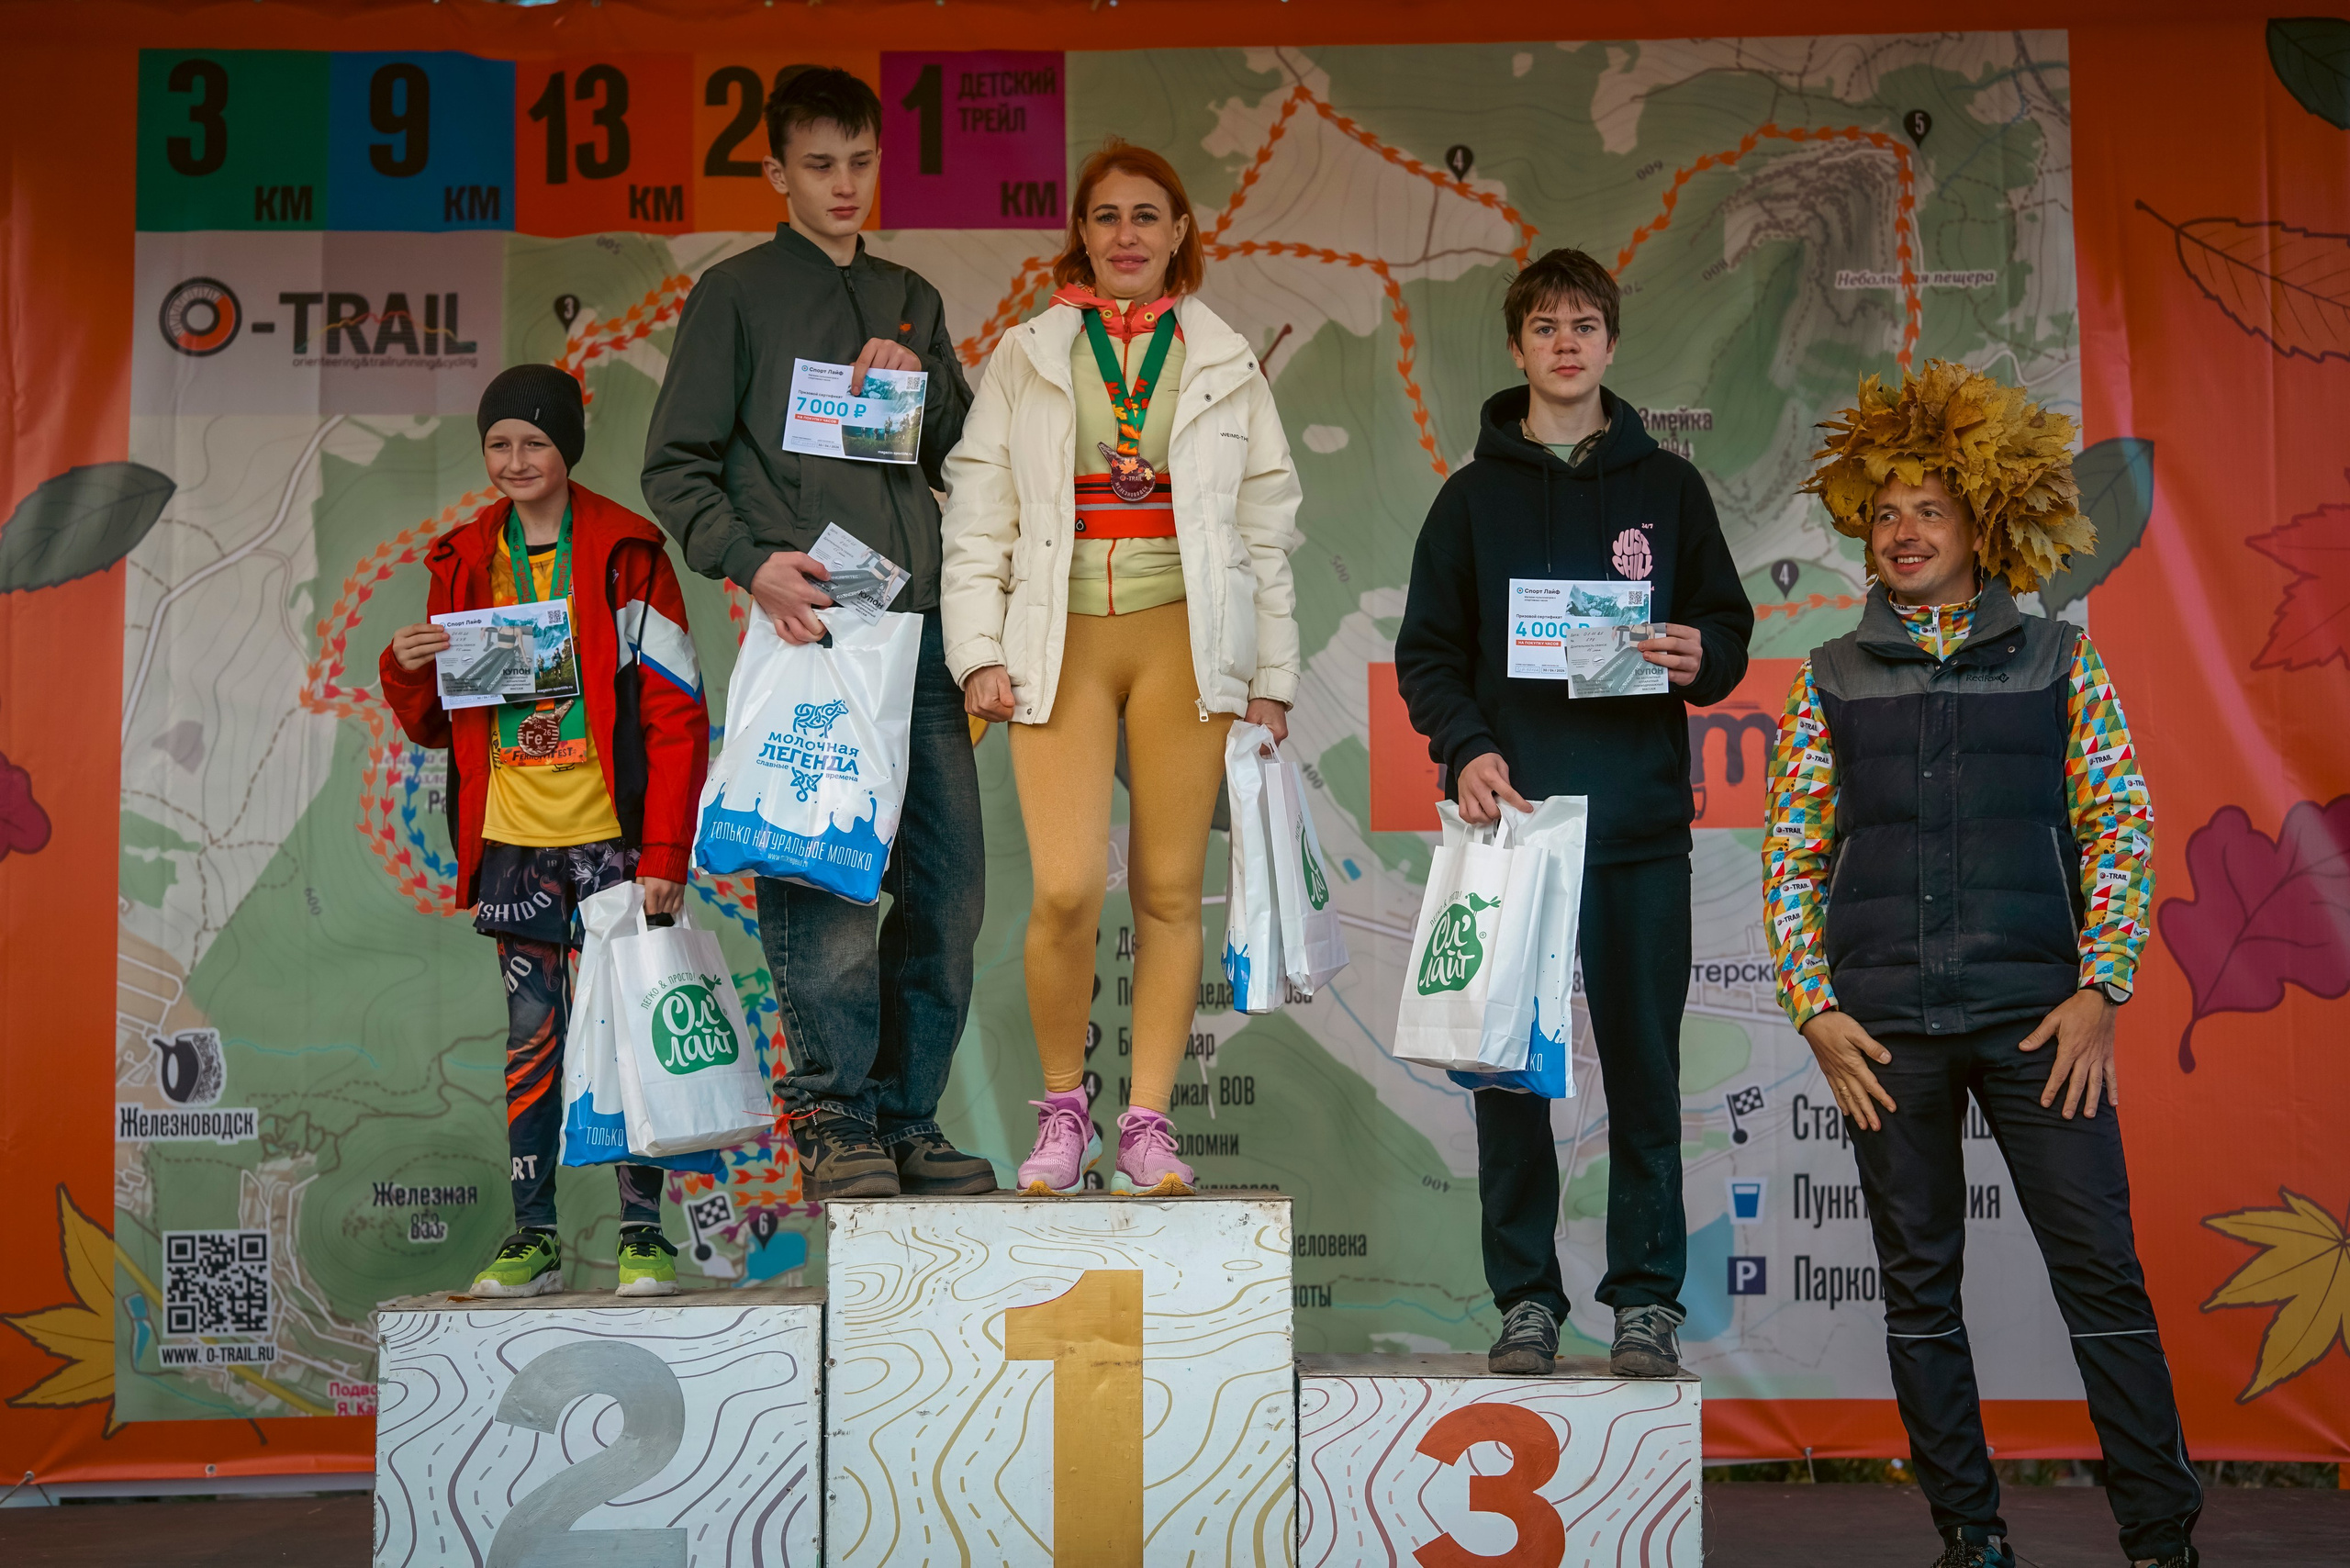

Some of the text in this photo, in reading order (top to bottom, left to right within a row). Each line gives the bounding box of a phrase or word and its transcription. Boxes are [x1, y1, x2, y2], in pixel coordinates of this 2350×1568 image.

[957, 68, 1057, 99] ДЕТСКИЙ
[166, 59, 229, 177] 3
[369, 62, 430, 178] 9
[527, 63, 631, 185] 13
[901, 63, 944, 175] 1
[957, 105, 1026, 133] ТРЕЙЛ
[1915, 112, 1926, 135] 5
[1453, 149, 1464, 171] 4
[254, 185, 313, 222] КМ
[443, 185, 500, 222] КМ
[629, 185, 685, 222] КМ
[1001, 182, 1058, 218] КМ
[563, 296, 575, 319] 3
[809, 366, 826, 375] Спорт
[1612, 528, 1651, 556] JUST
[1612, 553, 1653, 581] CHILL
[1779, 563, 1790, 585] 4
[858, 590, 885, 610] КУПОН
[502, 667, 531, 676] КУПОН
[1635, 667, 1664, 676] КУПОН
[525, 730, 543, 745] Fe
[543, 728, 552, 736] 26
[755, 758, 789, 770] славные
[758, 742, 859, 776] ЛЕГЕНДА
[825, 772, 858, 782] времена
[711, 821, 873, 871] ТОЛЬКО НАТУРАЛЬНОЕ МОЛОКО
[640, 987, 660, 1011] ЛЕГКО
[667, 972, 696, 985] ПРОСТО!
[1085, 1074, 1096, 1097] 4
[1220, 1077, 1255, 1104] ВОВ
[120, 1107, 254, 1140] Железноводск
[586, 1126, 624, 1147] ТОЛЬКО
[373, 1182, 478, 1206] Железная
[759, 1212, 769, 1235] 6
[162, 1347, 202, 1364] WWW.
[1005, 1270, 1144, 1568] 1
[487, 1339, 688, 1568] 2
[1412, 1402, 1567, 1568] 3
